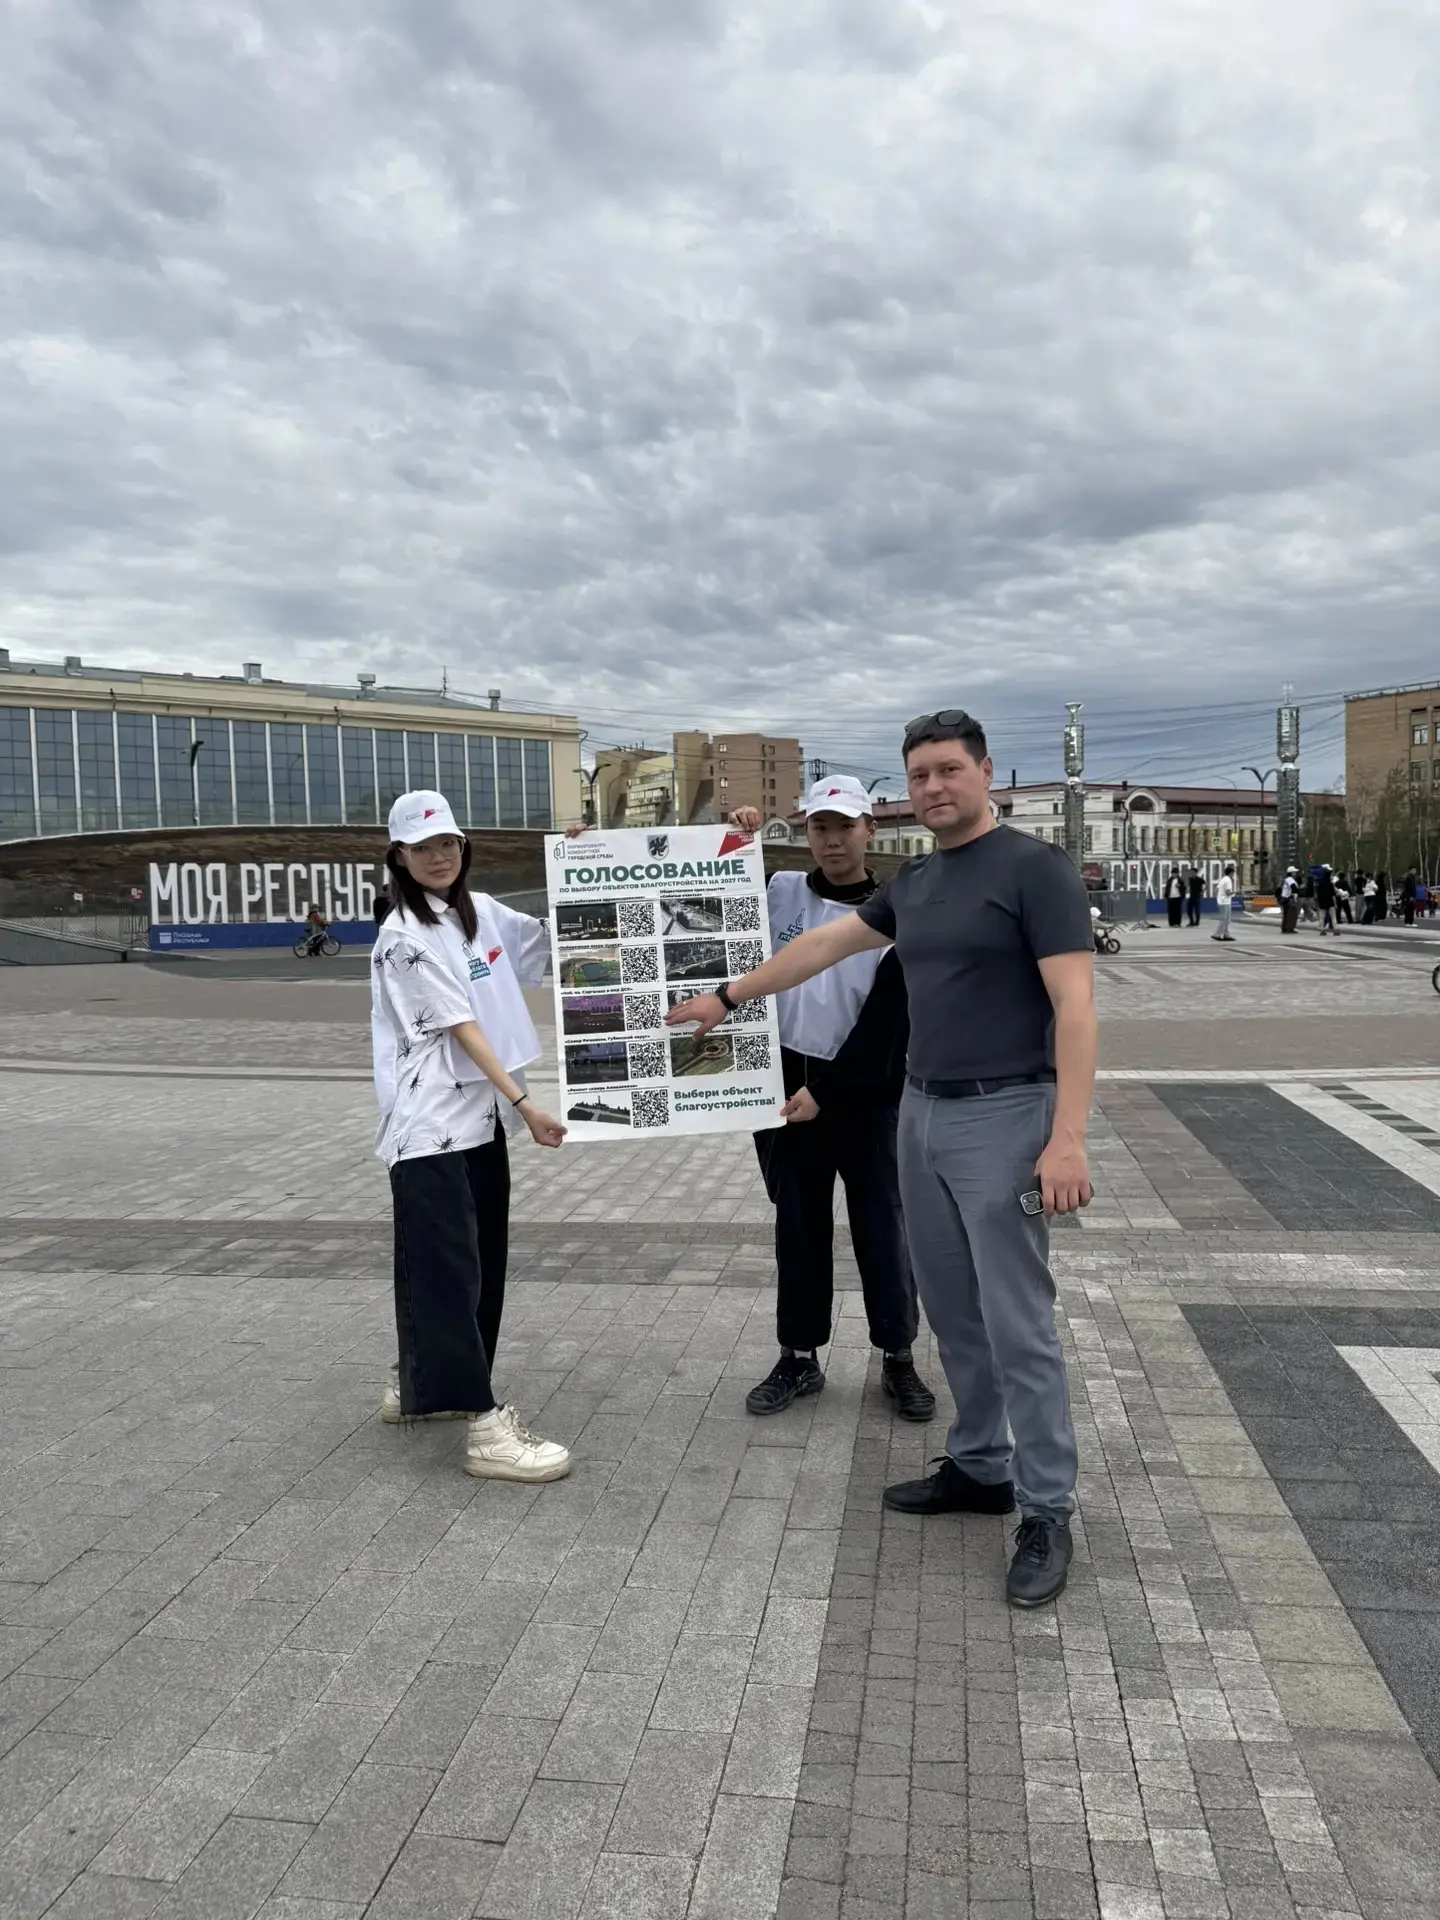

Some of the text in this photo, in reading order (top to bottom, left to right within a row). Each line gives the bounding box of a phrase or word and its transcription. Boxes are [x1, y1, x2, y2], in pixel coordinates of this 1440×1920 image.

[564, 859, 745, 885] ГОЛОСОВАНИЕ
[641, 879, 708, 888] БЛАГОУСТРОЙСТВА
[150, 862, 389, 925] МОЯ РЕСПУБ
[674, 1086, 763, 1100] Выбери объект
[675, 1097, 776, 1112] благоустройства!
